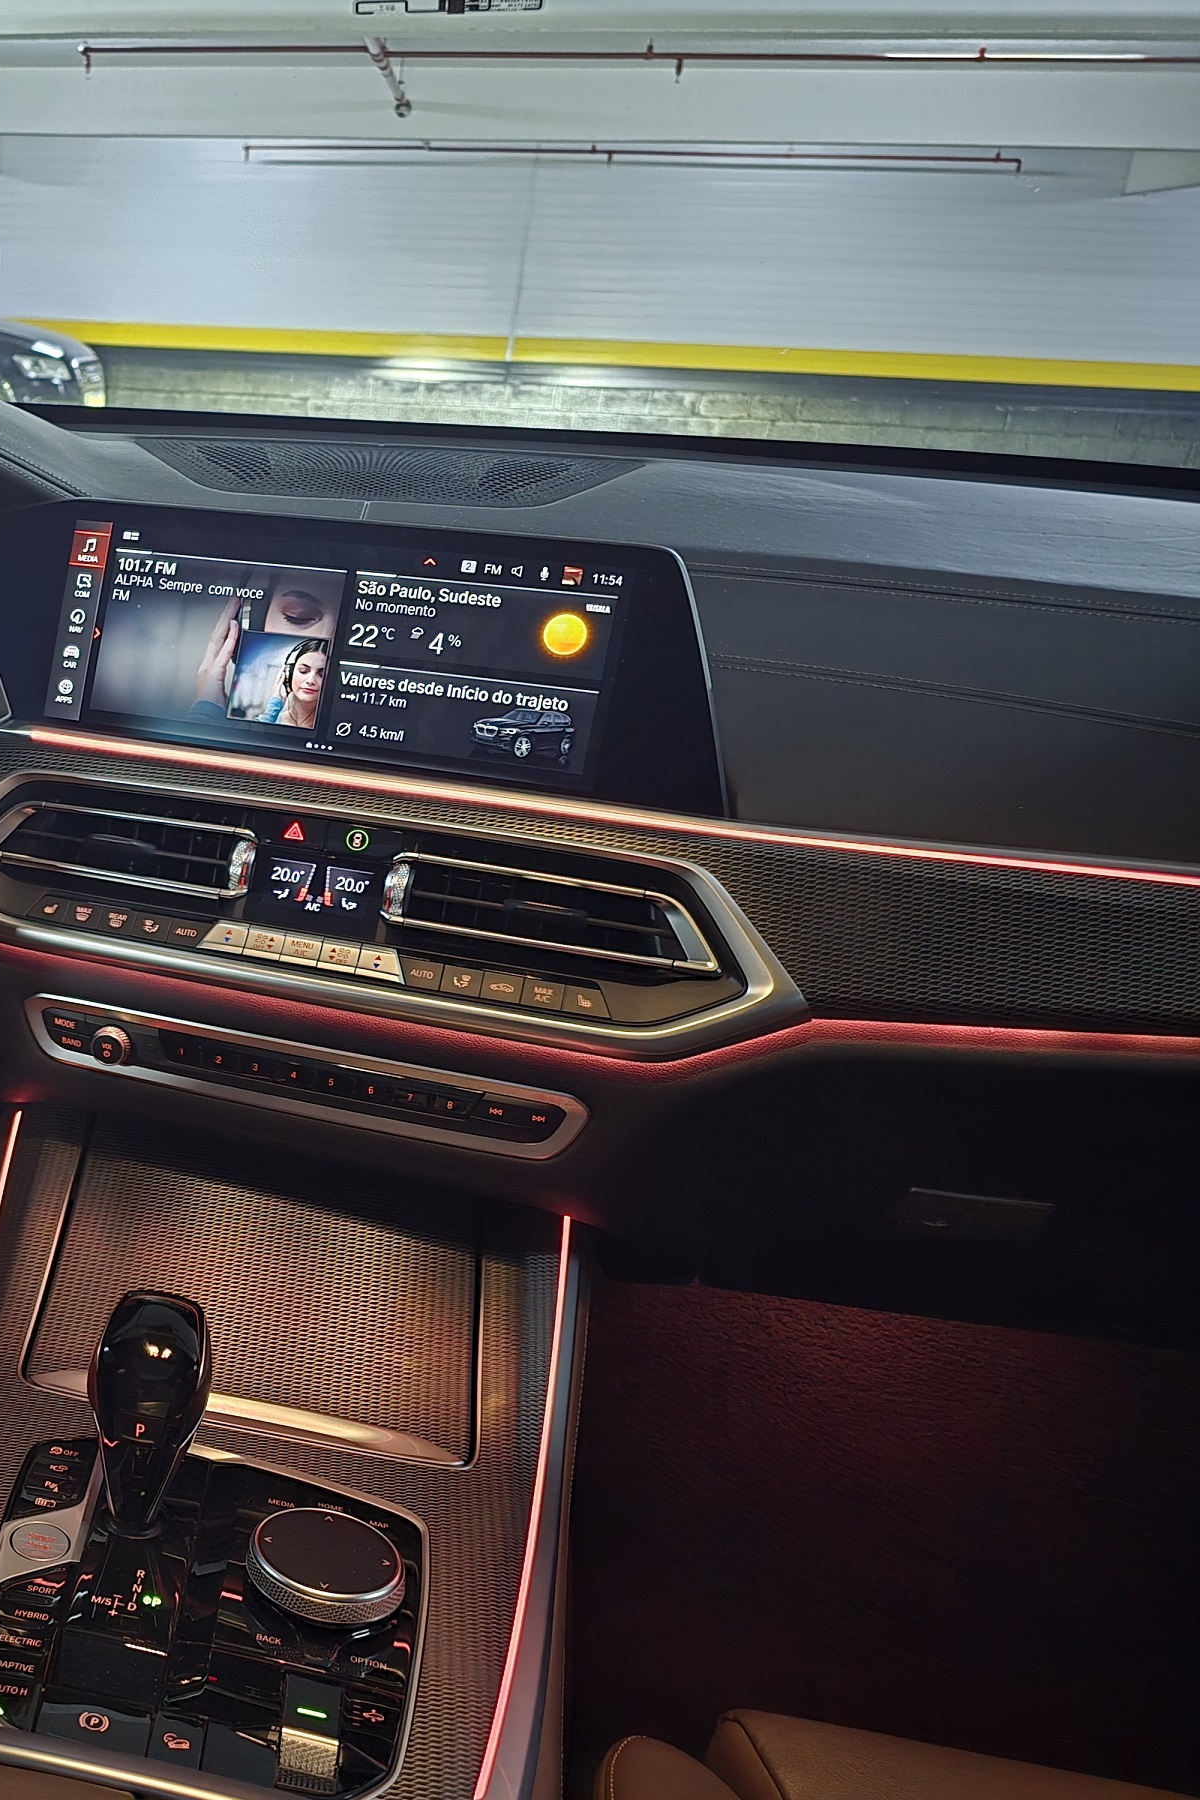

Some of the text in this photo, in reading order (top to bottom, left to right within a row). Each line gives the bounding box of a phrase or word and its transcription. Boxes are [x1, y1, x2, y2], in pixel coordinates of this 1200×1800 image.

[77, 554, 98, 563] MEDIA
[118, 558, 177, 575] 101.7 FM
[484, 564, 502, 575] FM
[592, 574, 623, 586] 11:54
[114, 574, 263, 600] ALPHA Sempre com voce
[74, 590, 90, 598] COM
[112, 589, 130, 601] FM
[358, 580, 502, 608] São Paulo, Sudeste
[355, 599, 436, 618] No momento
[69, 625, 83, 634] NAV
[63, 661, 77, 669] CAR
[340, 671, 569, 712] Valores desde Início do trajeto
[55, 695, 73, 704] APPS
[362, 692, 407, 709] 11.7 km
[359, 725, 404, 741] 4.5 km/l
[76, 906, 93, 915] MAX
[304, 902, 321, 912] A/C
[109, 912, 128, 922] REAR
[175, 927, 197, 938] AUTO
[291, 940, 315, 950] MENU
[410, 968, 434, 980] AUTO
[533, 986, 554, 996] MAX
[533, 995, 551, 1004] A/C
[54, 1018, 76, 1029] MODE
[61, 1037, 82, 1048] BAND
[215, 1056, 222, 1064] 2
[252, 1063, 259, 1072] 3
[290, 1071, 297, 1079] 4
[328, 1078, 334, 1086] 5
[368, 1086, 374, 1095] 6
[407, 1094, 414, 1102] 7
[446, 1101, 454, 1110] 8
[135, 1423, 146, 1437] P
[63, 1449, 80, 1457] OFF
[268, 1498, 295, 1509] MEDIA
[317, 1502, 344, 1512] HOME
[369, 1520, 389, 1529] MAP
[137, 1569, 146, 1578] R
[27, 1585, 57, 1595] SPORT
[132, 1584, 142, 1593] N
[91, 1595, 112, 1606] M/S
[127, 1602, 137, 1611] D
[15, 1609, 49, 1621] HYBRID
[0, 1634, 42, 1648] ELECTRIC
[256, 1633, 281, 1645] BACK
[350, 1655, 388, 1670] OPTION
[19, 1688, 28, 1696] H
